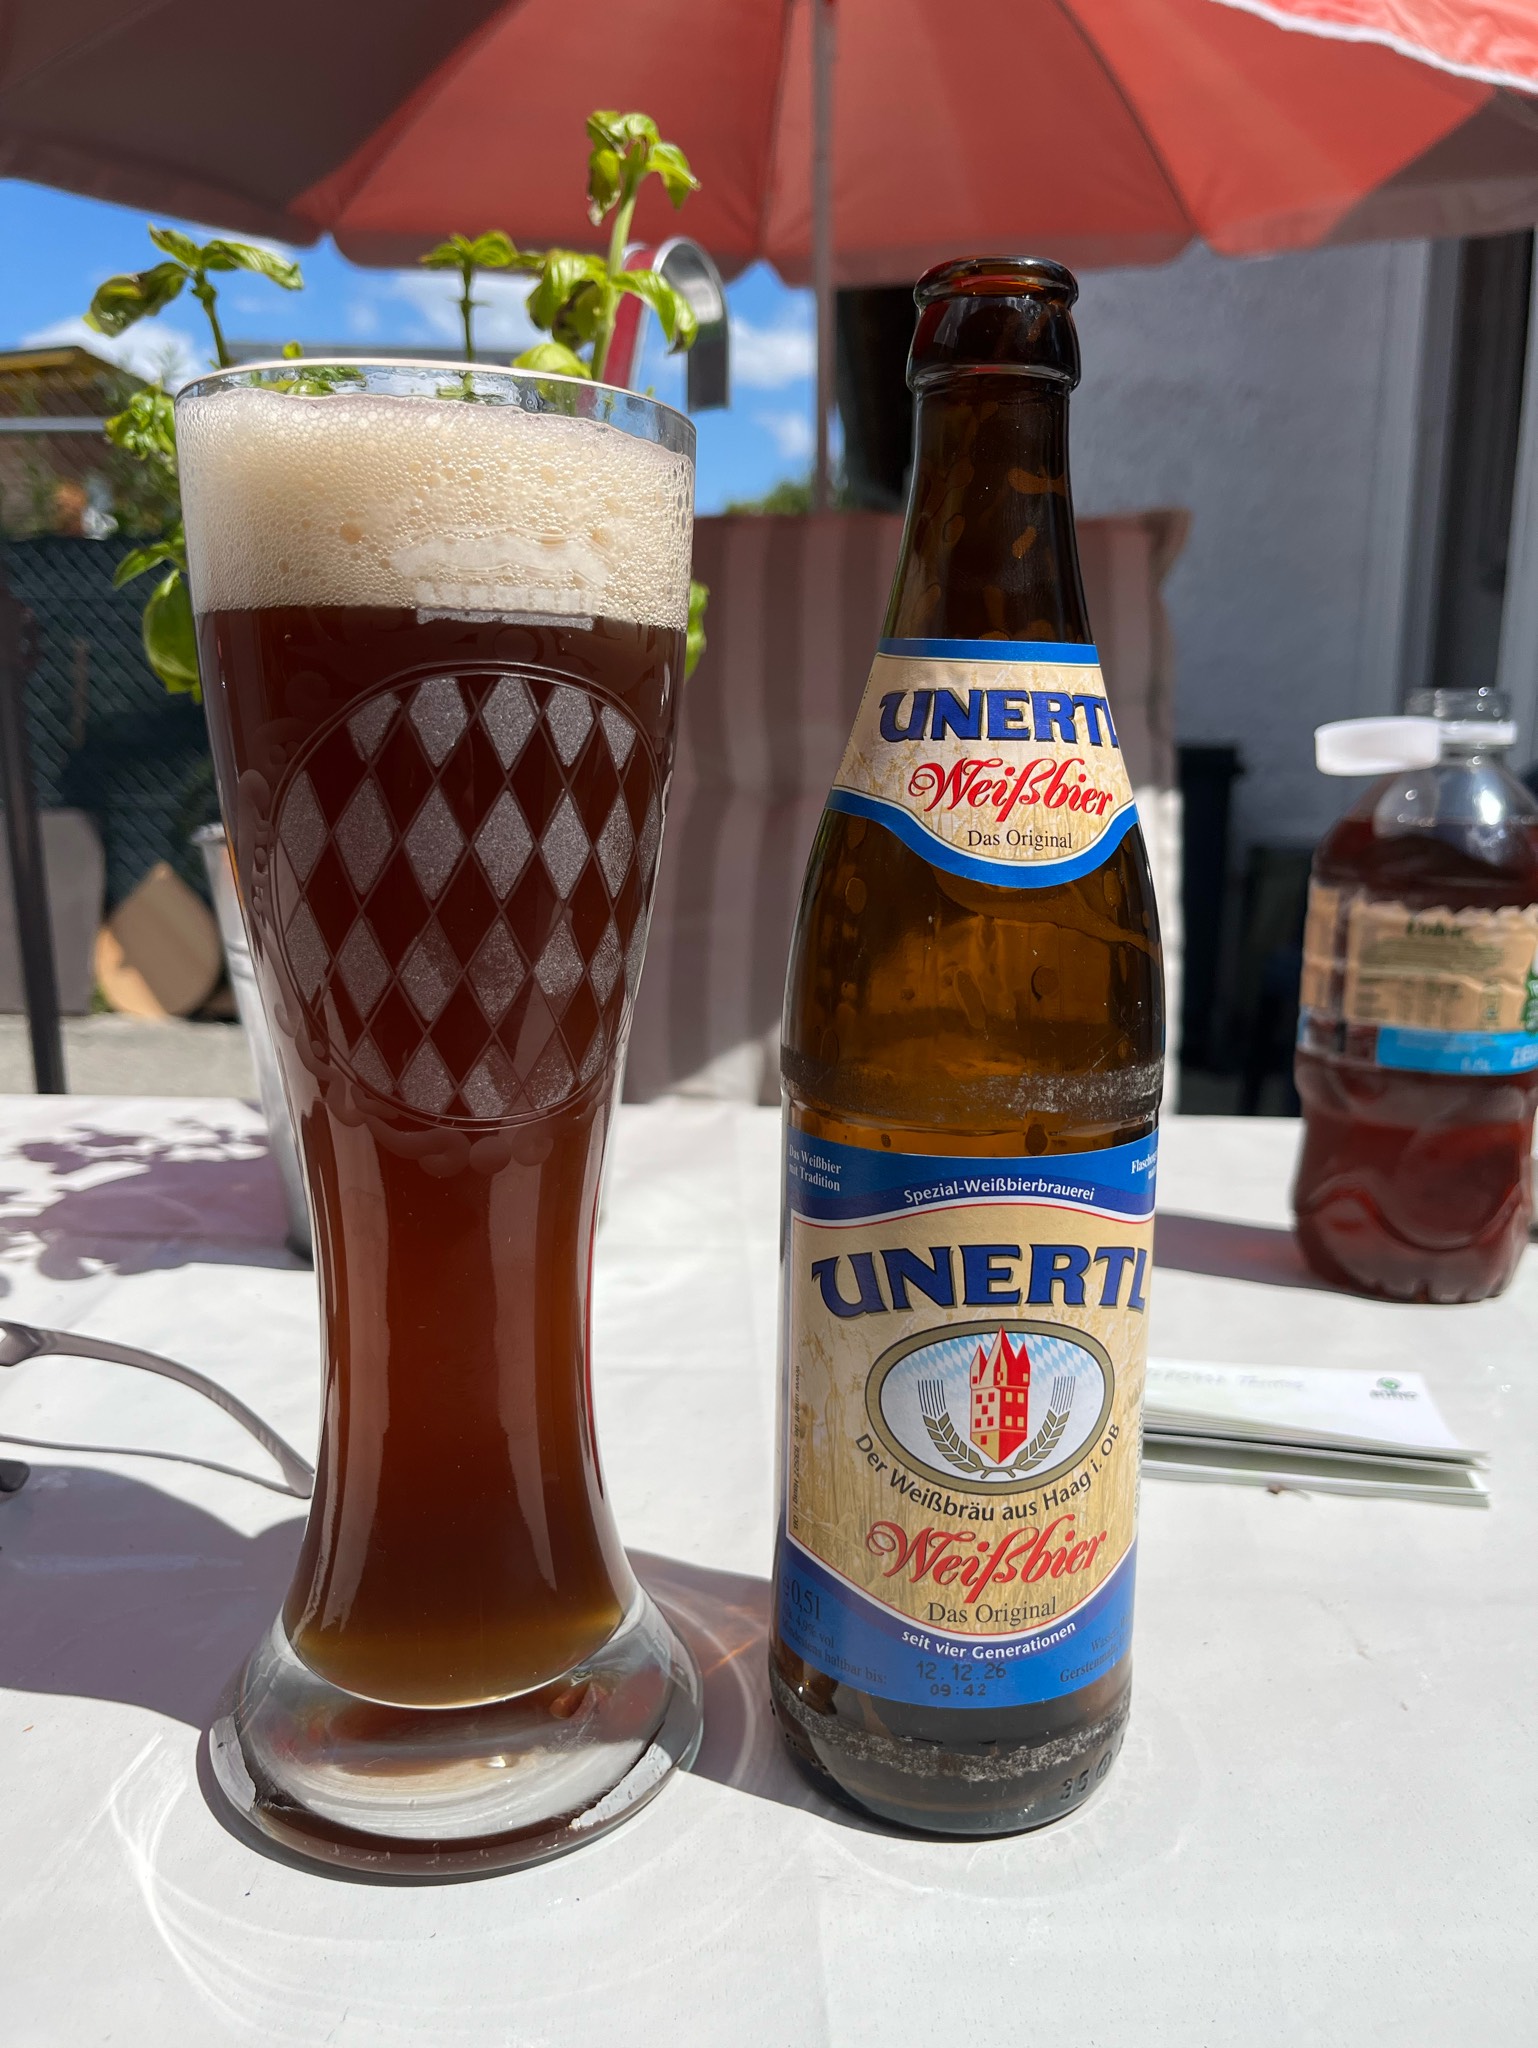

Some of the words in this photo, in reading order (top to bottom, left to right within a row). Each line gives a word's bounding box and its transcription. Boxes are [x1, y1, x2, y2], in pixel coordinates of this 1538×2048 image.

[907, 756, 1113, 823] Weißbier
[967, 829, 1001, 848] Das
[1005, 829, 1073, 853] Original
[789, 1144, 800, 1161] Das
[800, 1149, 842, 1175] Weißbier
[799, 1165, 841, 1192] Tradition
[903, 1177, 1095, 1206] Spezial-Weißbierbrauerei
[811, 1243, 1148, 1320] UNERTL
[855, 1432, 888, 1474] Der
[888, 1467, 995, 1522] Weißbräu
[1001, 1500, 1038, 1522] aus
[1041, 1471, 1092, 1511] Haag
[1090, 1458, 1103, 1474] i.
[1100, 1423, 1121, 1458] OB
[866, 1513, 1108, 1604] Weißbier
[927, 1601, 968, 1624] Das
[975, 1595, 1057, 1627] Original
[901, 1631, 931, 1651] seit
[935, 1641, 967, 1658] vier
[971, 1621, 1077, 1660] Generationen
[824, 1650, 863, 1677] haltbar
[929, 1682, 987, 1697] 09:42
